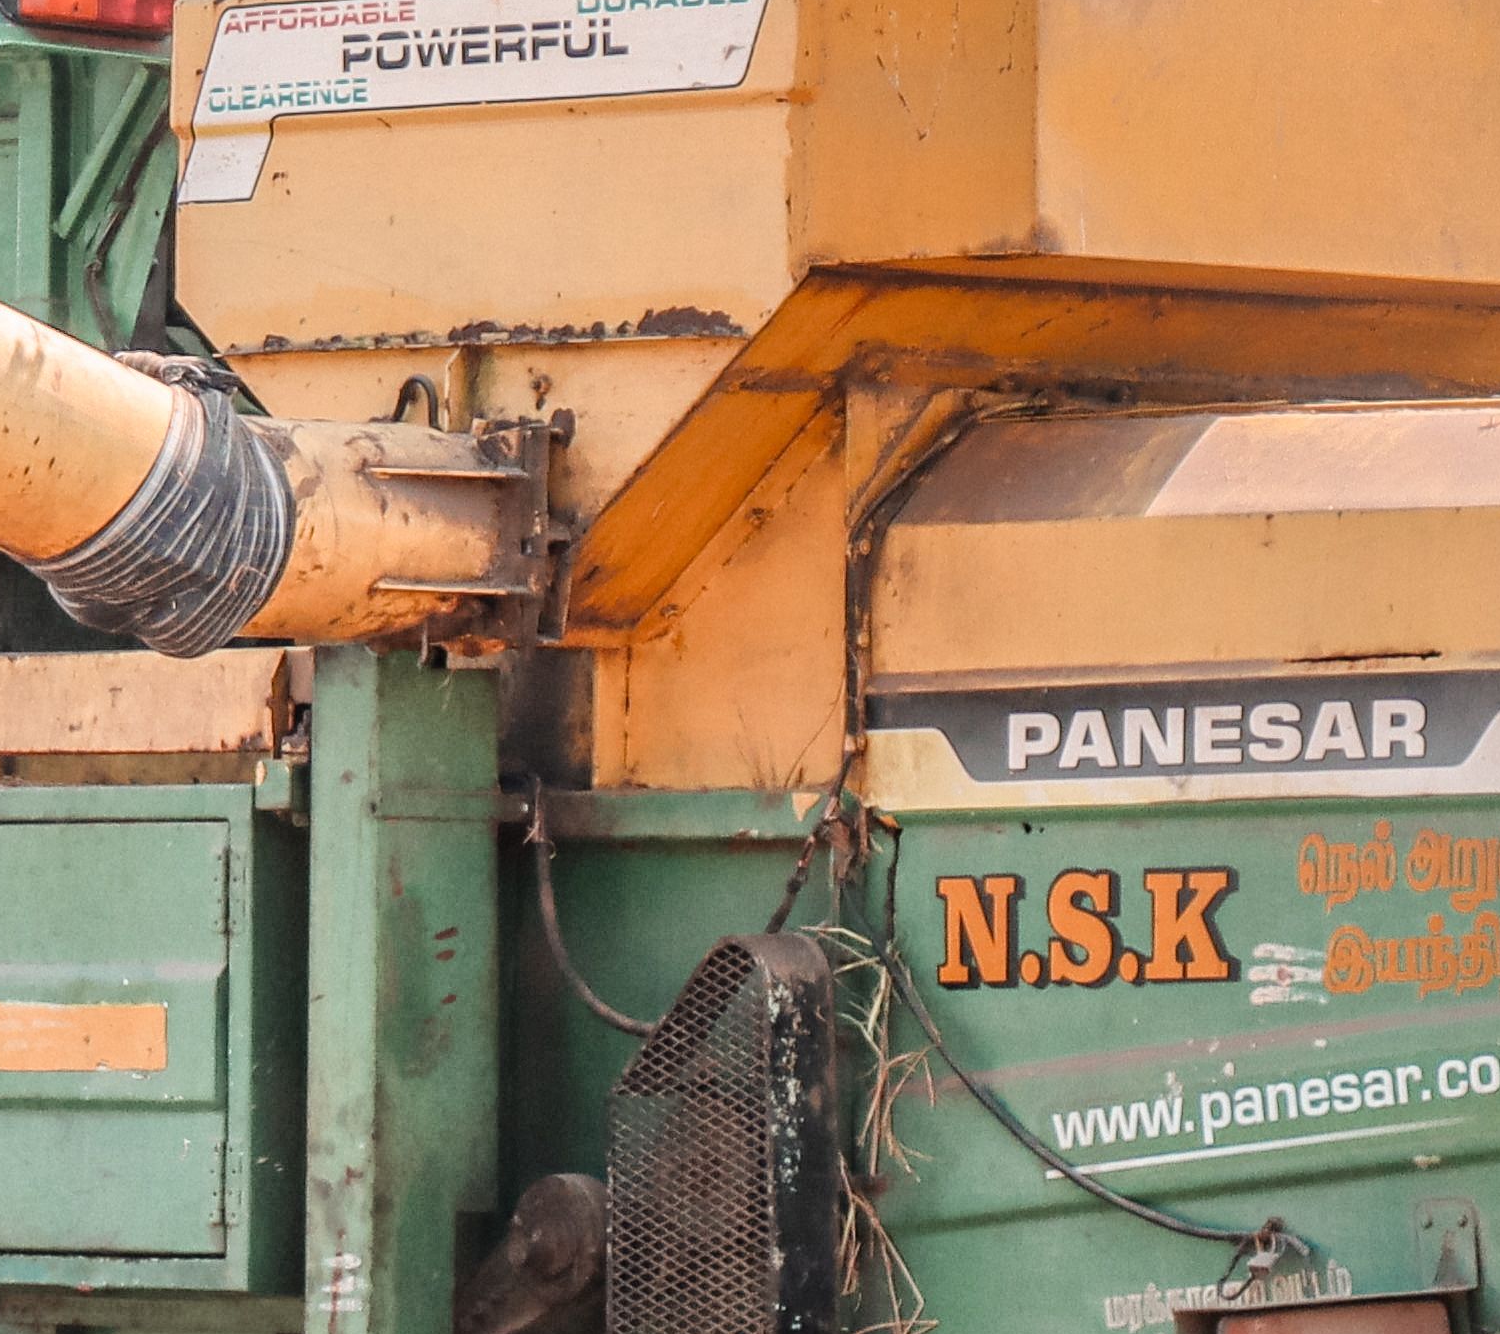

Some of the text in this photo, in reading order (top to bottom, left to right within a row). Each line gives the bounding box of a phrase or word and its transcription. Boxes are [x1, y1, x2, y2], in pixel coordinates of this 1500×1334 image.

[223, 0, 417, 35] AFFORDABLE
[341, 17, 630, 73] POWERFUL
[207, 77, 369, 114] CLEARENCE
[1007, 699, 1427, 771] PANESAR
[936, 868, 1238, 988] N.S.K
